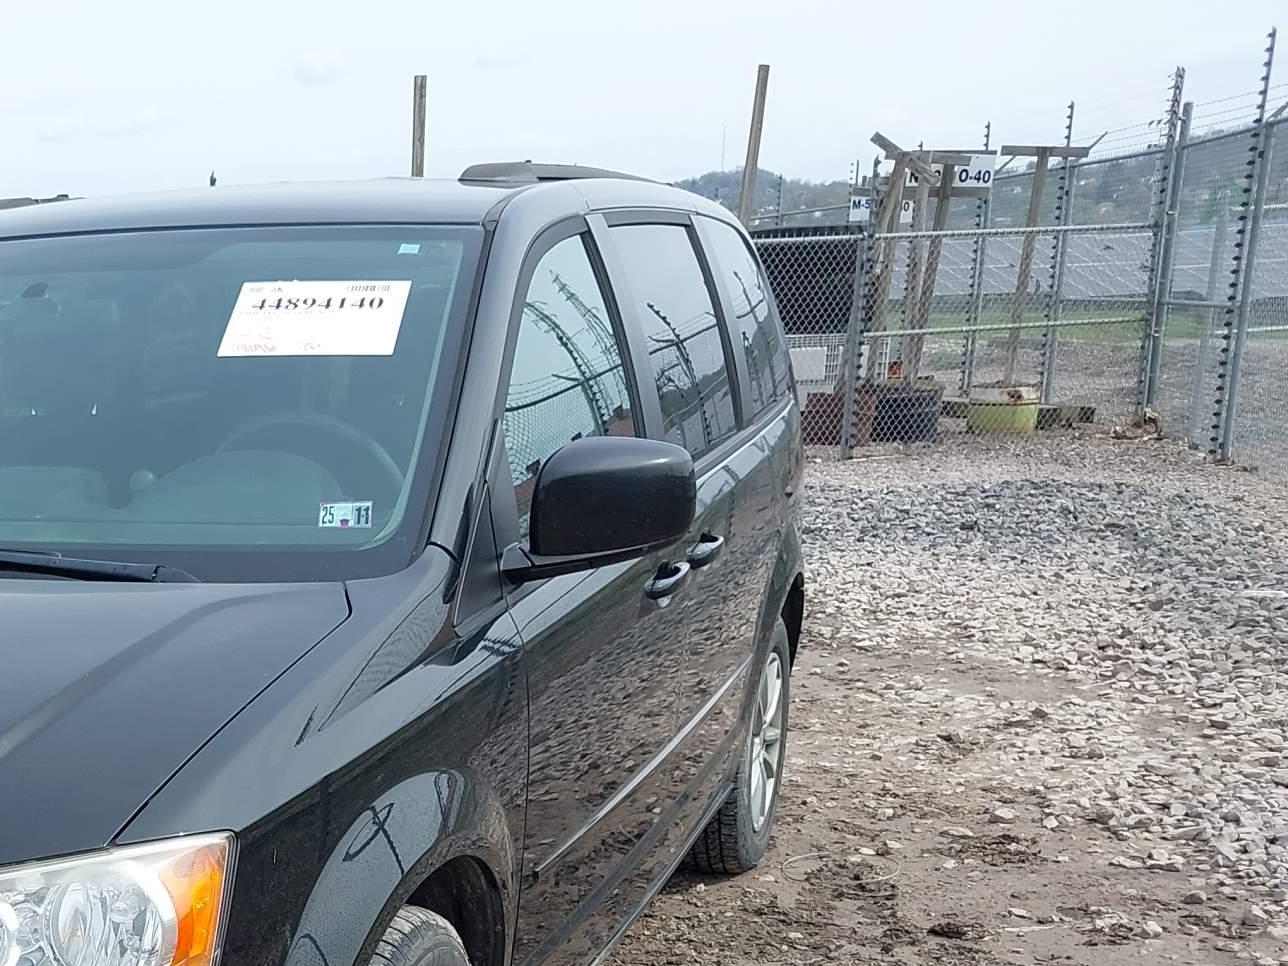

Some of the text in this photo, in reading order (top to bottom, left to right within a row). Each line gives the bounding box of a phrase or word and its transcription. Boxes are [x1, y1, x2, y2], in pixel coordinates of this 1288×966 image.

[958, 168, 991, 184] O-40
[252, 296, 385, 311] 44894140
[322, 505, 370, 526] 25 11
